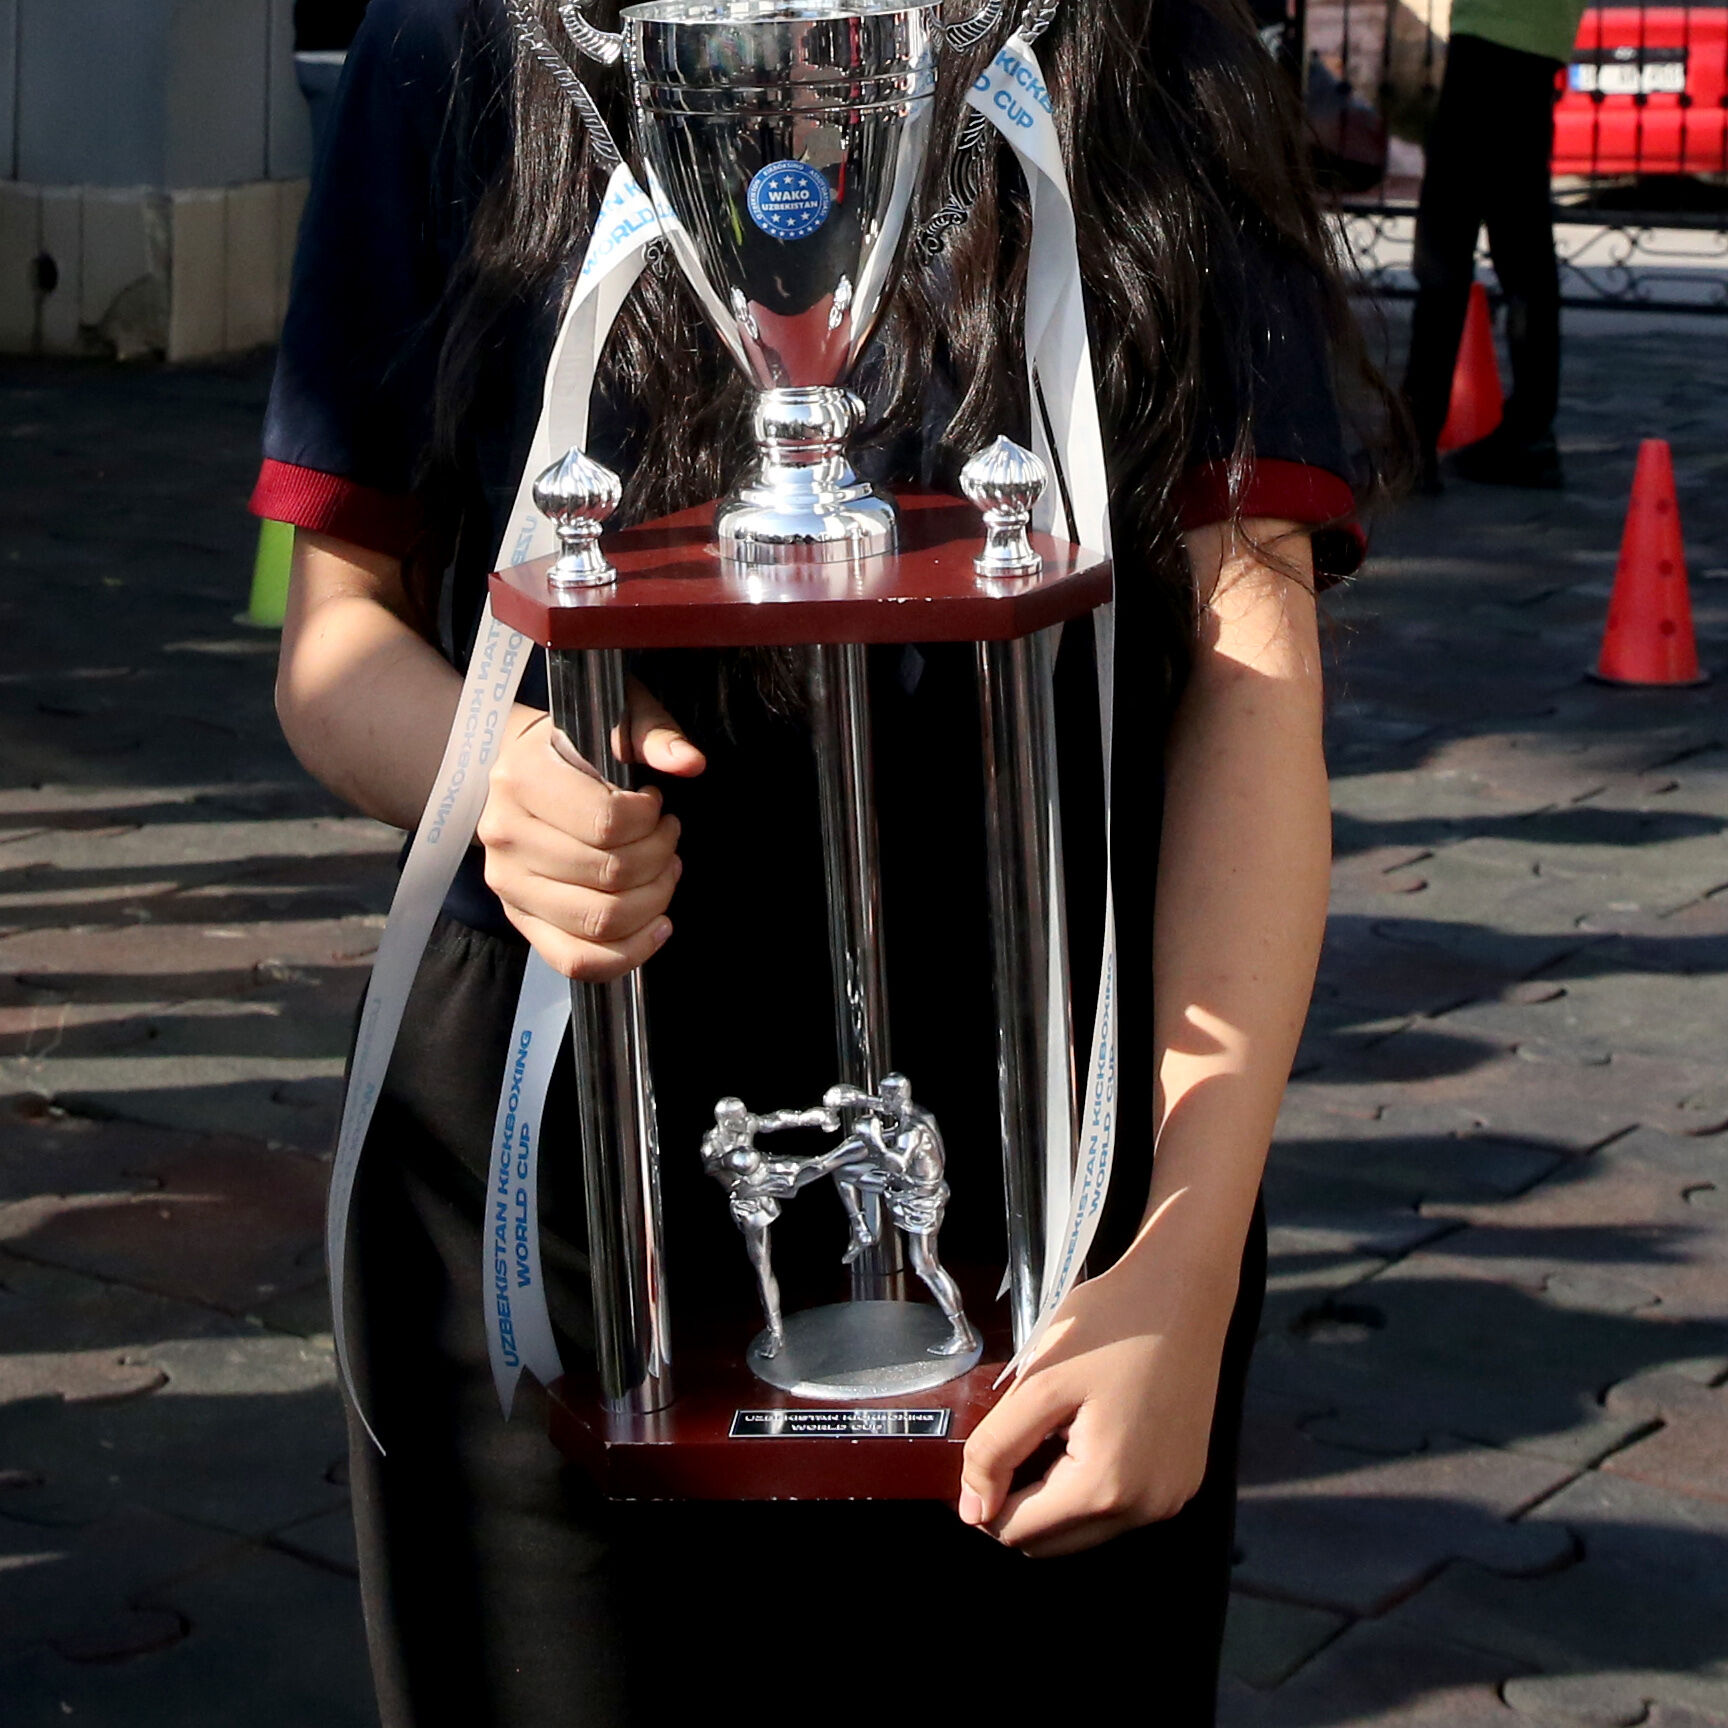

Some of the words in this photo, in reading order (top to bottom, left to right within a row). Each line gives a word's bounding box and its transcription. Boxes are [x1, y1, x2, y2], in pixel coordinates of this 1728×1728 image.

[993, 90, 1034, 129] CUP
[761, 201, 819, 211] UZBEKISTAN
[768, 189, 810, 202] WAKO
[582, 207, 655, 275] WORLD
[497, 1029, 533, 1196] KICKBOXING
[517, 1122, 531, 1181] CUP
[1050, 1134, 1098, 1310] UZBEKISTAN
[1092, 952, 1113, 1127] KICKBOXING
[1088, 1111, 1113, 1217] WORLD
[515, 1186, 532, 1289] WORLD
[494, 1200, 520, 1369] UZBEKISTAN
